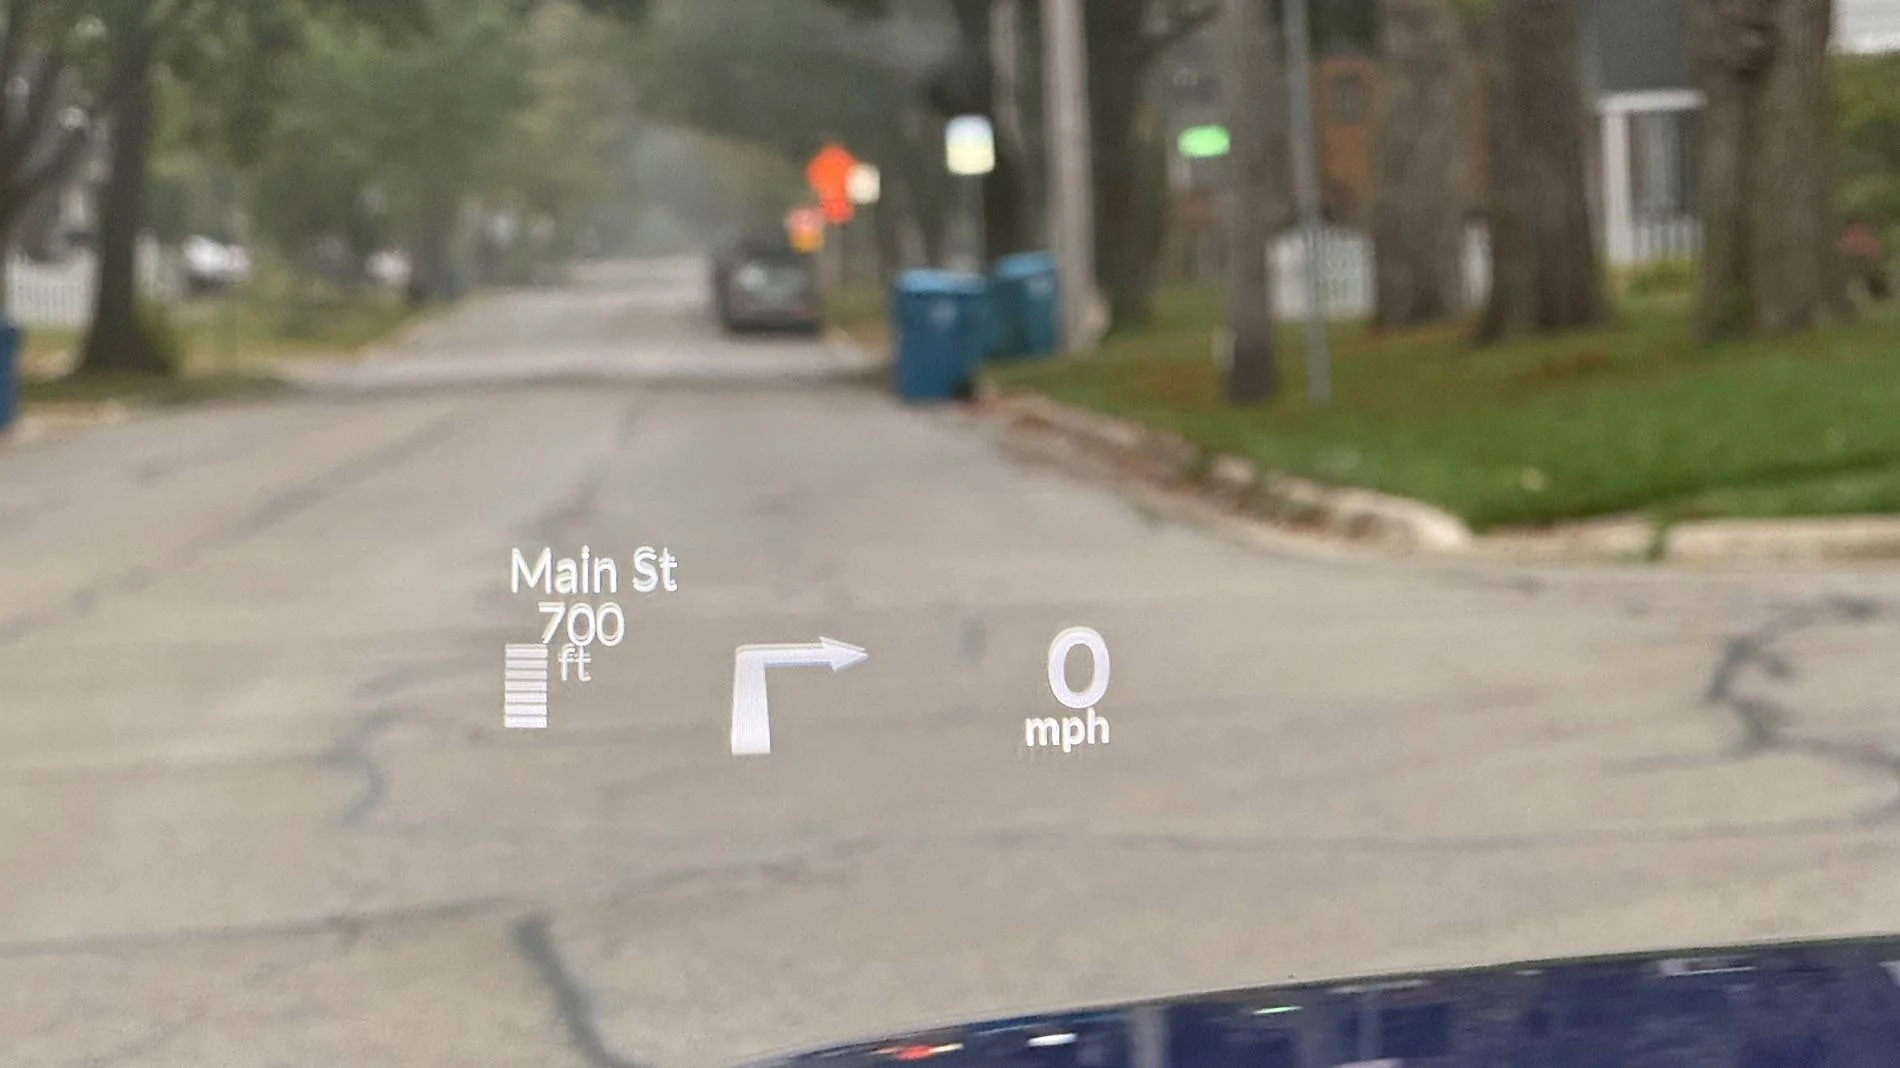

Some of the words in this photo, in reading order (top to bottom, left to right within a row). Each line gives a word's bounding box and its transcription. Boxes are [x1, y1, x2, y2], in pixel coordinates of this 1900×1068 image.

[510, 545, 617, 594] Main
[632, 546, 678, 592] St
[538, 602, 625, 646] 700
[558, 643, 592, 681] ft
[1048, 626, 1110, 709] 0
[1025, 707, 1110, 753] mph
